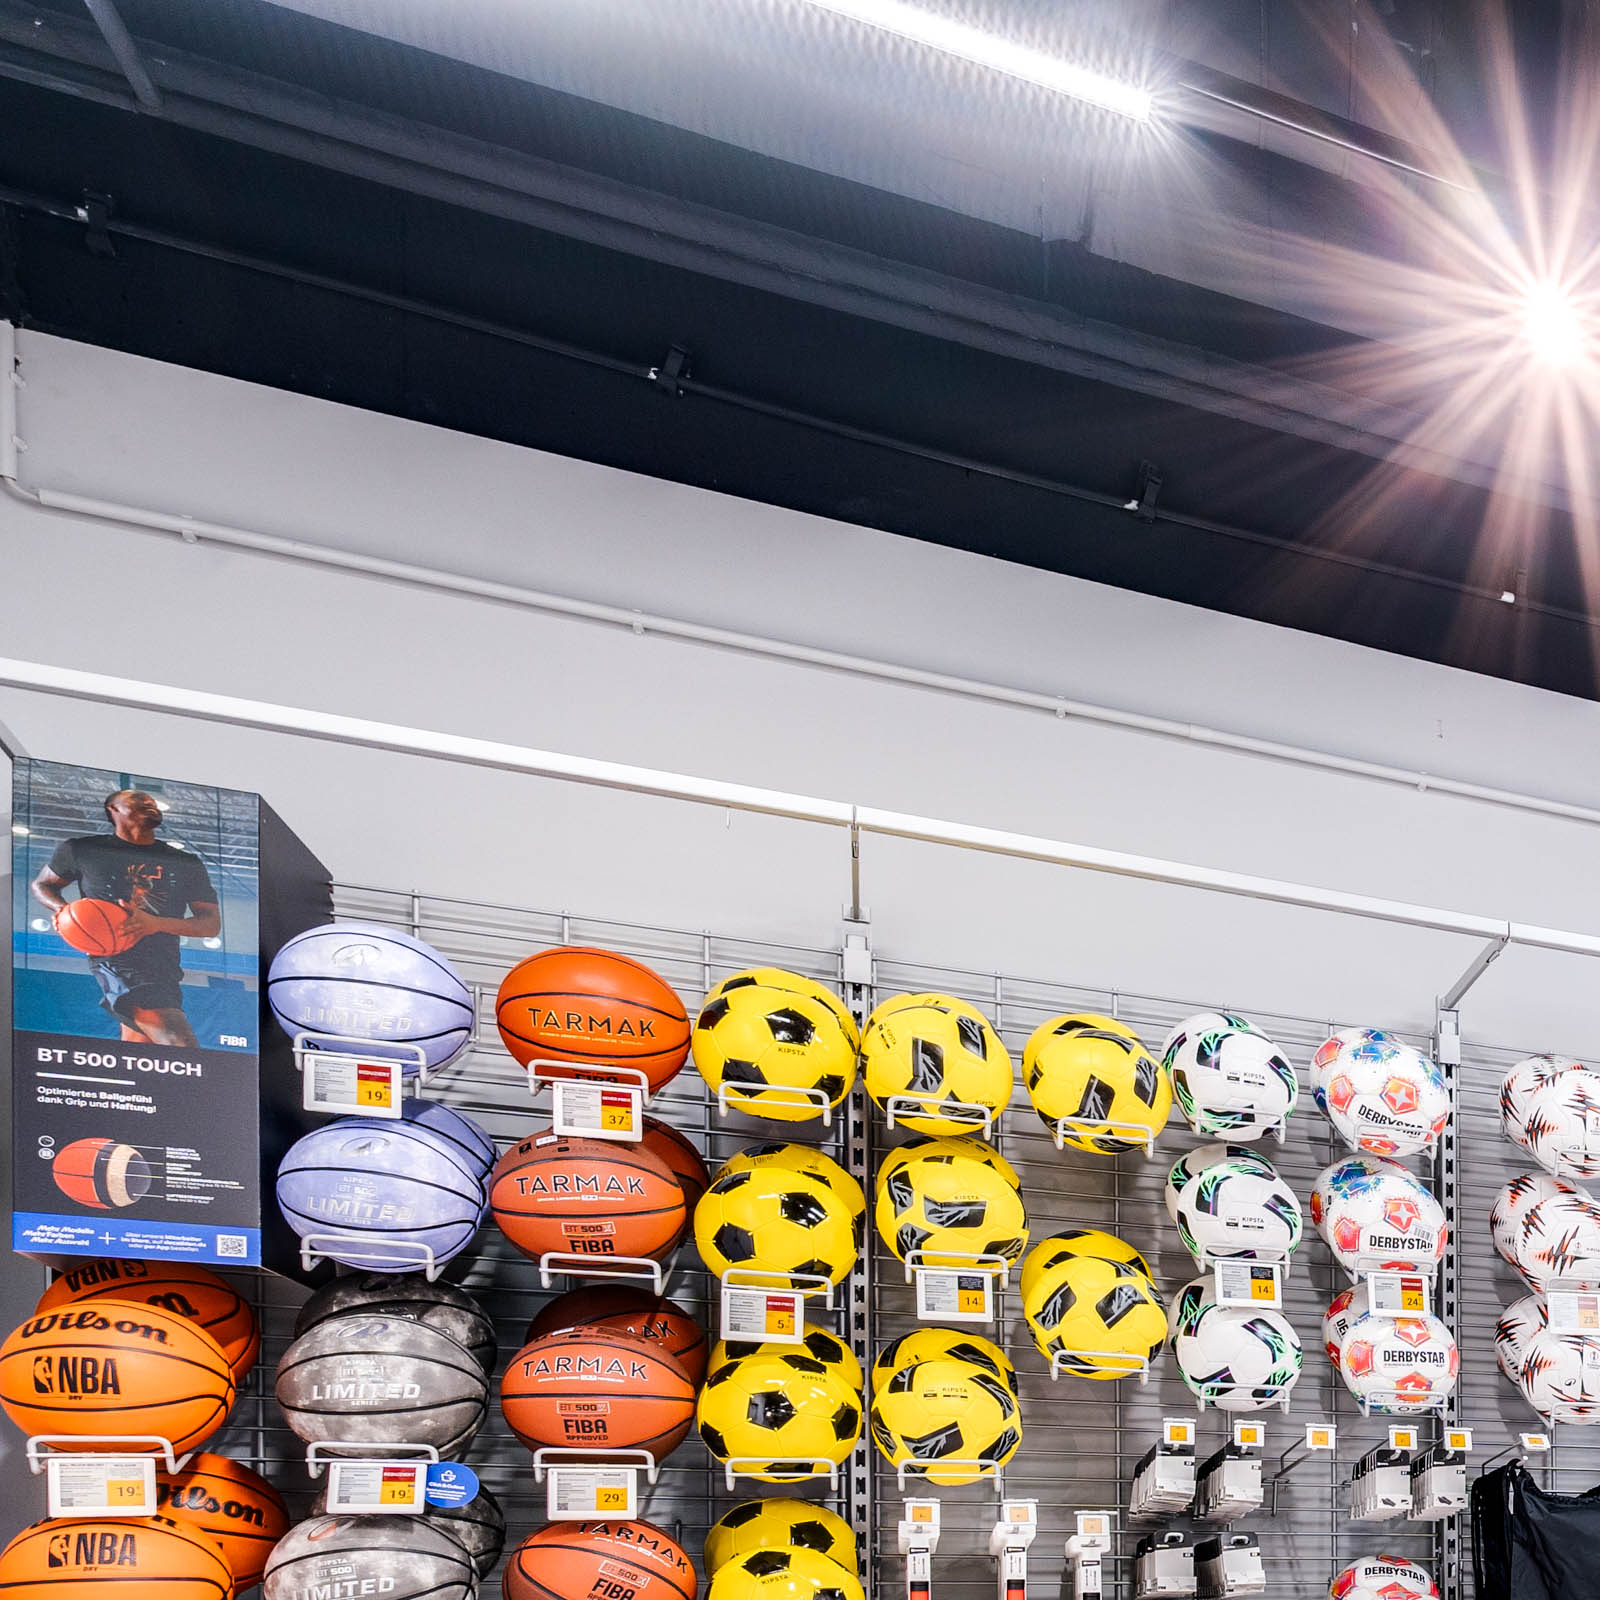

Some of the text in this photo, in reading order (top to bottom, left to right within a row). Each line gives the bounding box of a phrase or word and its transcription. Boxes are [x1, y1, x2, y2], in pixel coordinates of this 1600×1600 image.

[303, 1007, 412, 1032] LIMITED
[528, 1008, 656, 1038] TARMAK
[220, 1035, 248, 1048] FIBA
[777, 1047, 807, 1057] KIPSTA
[37, 1047, 202, 1077] BT 500 TOUCH
[1243, 1072, 1267, 1082] KIPSTA
[37, 1086, 152, 1104] Optimiertes Ballgefühl
[367, 1090, 383, 1101] 19
[37, 1095, 157, 1114] dank Grip und Haftung!
[609, 1114, 625, 1126] 37
[515, 1173, 647, 1197] TARMAK
[307, 1196, 415, 1223] LIMITED
[1240, 1216, 1264, 1225] KIPSTA
[570, 1239, 615, 1253] FIBA
[65, 1260, 121, 1292] NBA
[1256, 1285, 1268, 1296] 14
[964, 1296, 979, 1307] 14
[1403, 1297, 1417, 1308] 24
[21, 1311, 169, 1345] Wilson
[1381, 1350, 1445, 1364] DERBYSTAR
[58, 1356, 121, 1395] NBA
[523, 1356, 648, 1381] TARMAK
[312, 1383, 422, 1400] LIMITED
[563, 1418, 608, 1434] FIBA
[117, 1486, 135, 1497] 19
[390, 1489, 406, 1499] 19
[604, 1493, 619, 1503] 29
[75, 1532, 137, 1567] NBA
[576, 1522, 688, 1575] TARMAK
[330, 1566, 353, 1576] 500
[1364, 1566, 1426, 1586] DERBYSTAR
[761, 1575, 789, 1585] KIPSTA
